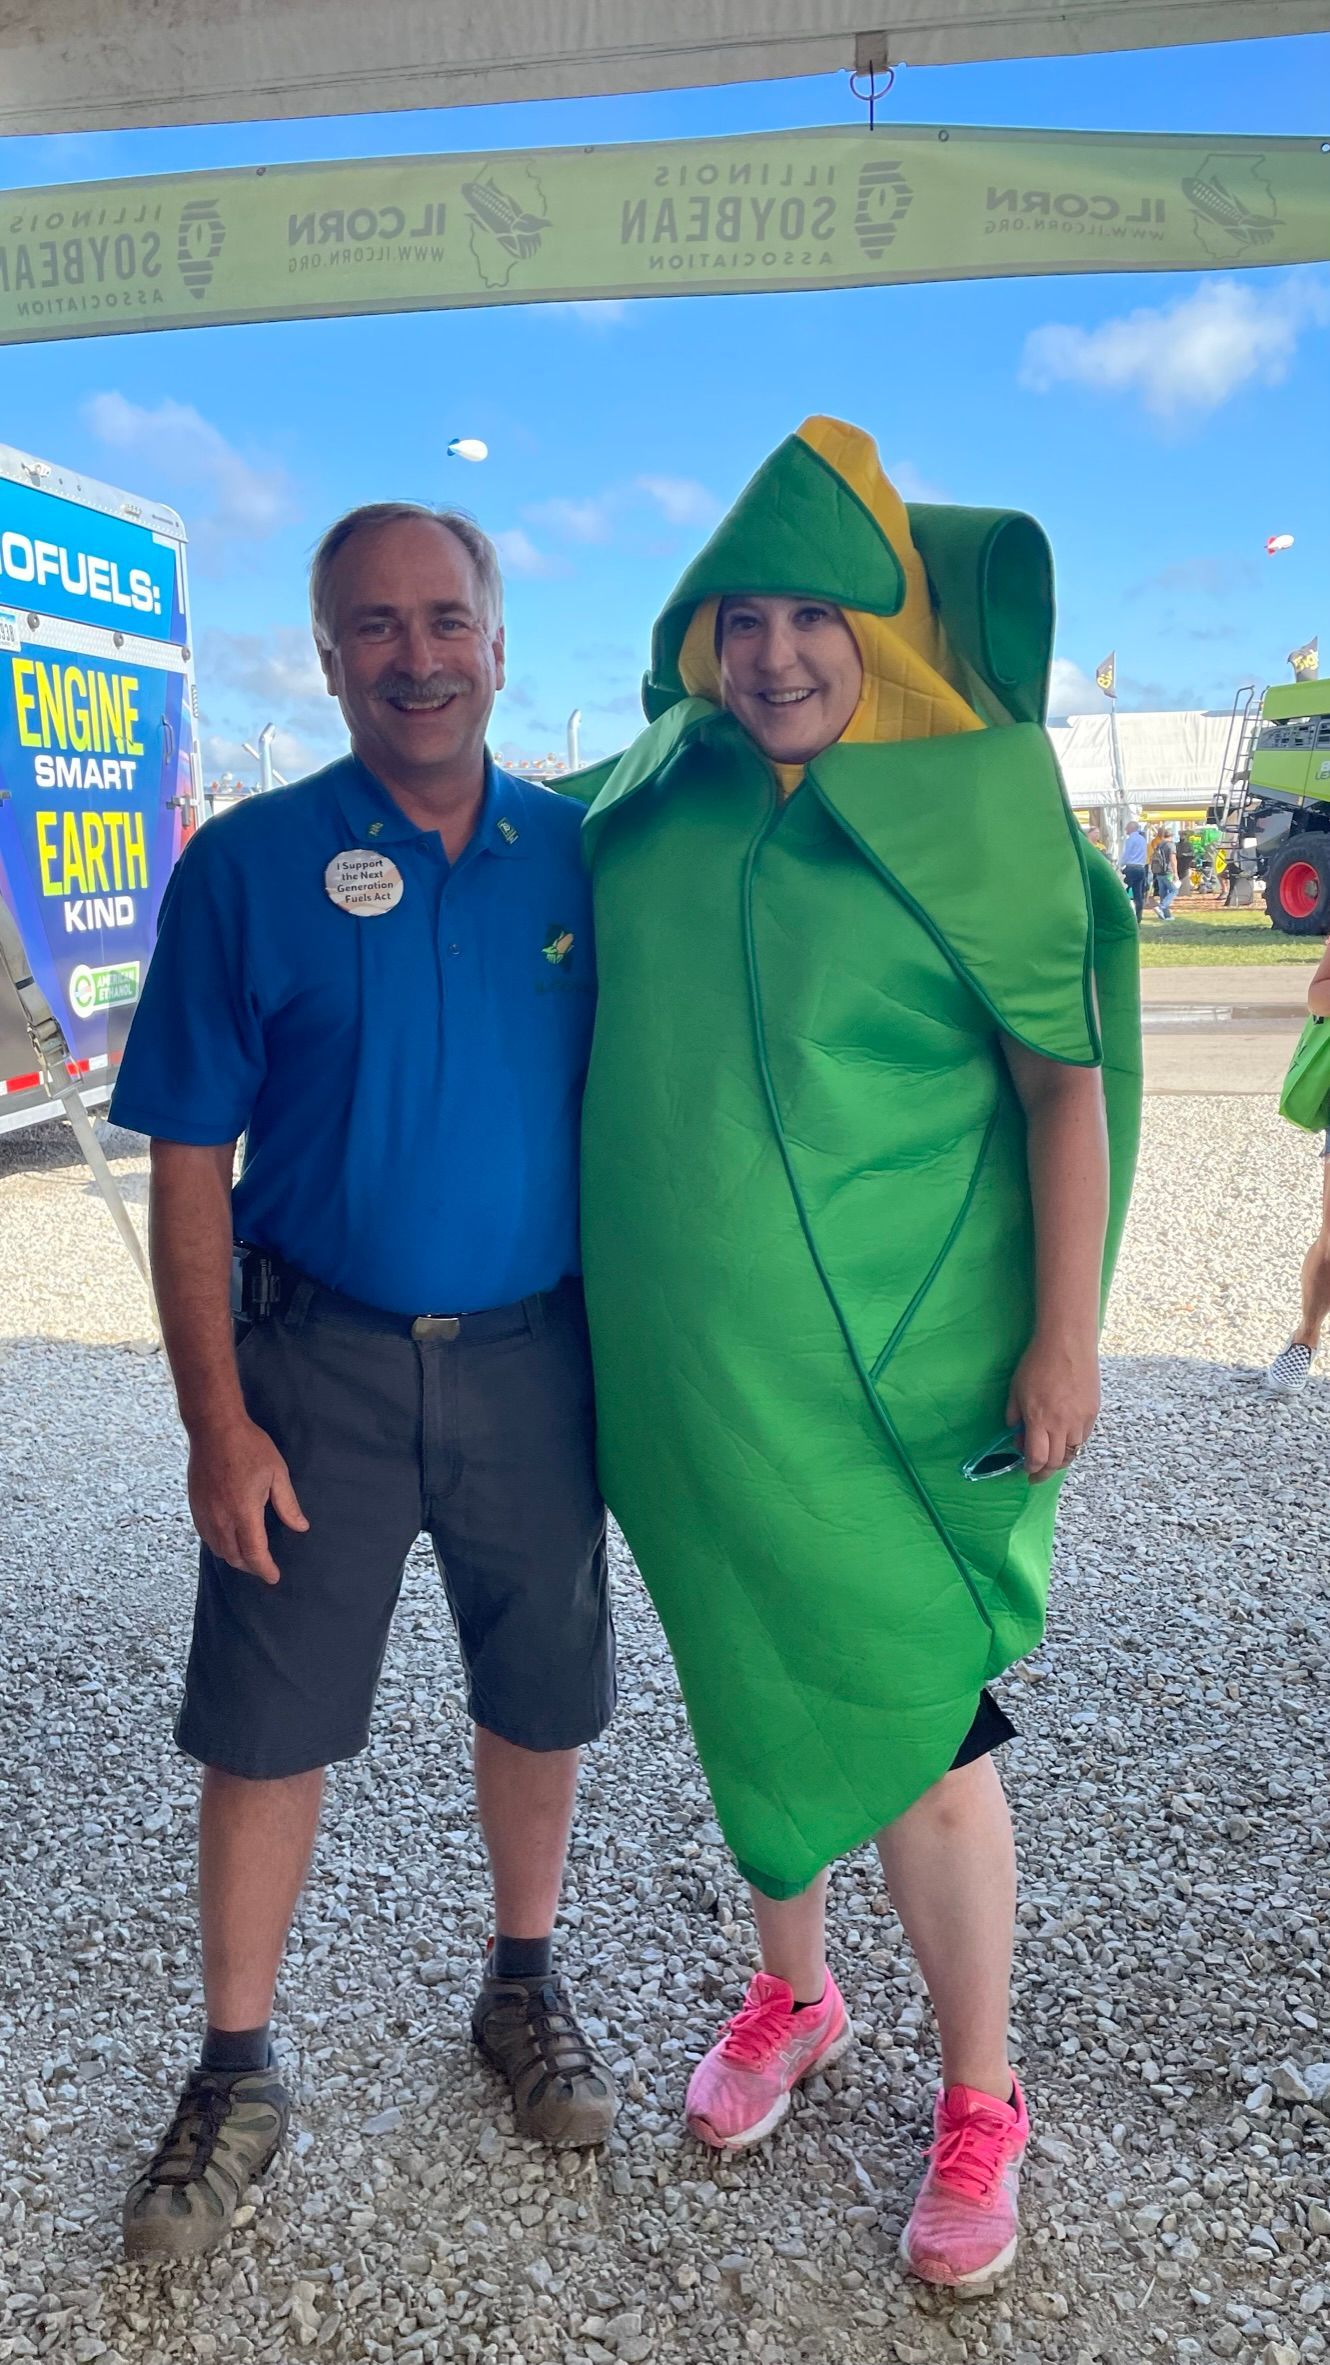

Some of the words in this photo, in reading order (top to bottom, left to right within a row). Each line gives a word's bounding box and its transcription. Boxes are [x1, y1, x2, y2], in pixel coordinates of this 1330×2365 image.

[0, 530, 162, 616] OFUELS:
[12, 657, 145, 756] ENGINE
[34, 754, 137, 790] SMART
[35, 811, 148, 897] EARTH
[342, 860, 383, 870] Support
[337, 881, 394, 893] Generation
[342, 872, 358, 881] the
[361, 871, 383, 880] Next
[345, 893, 372, 903] Fuels
[374, 892, 392, 901] Act
[64, 895, 135, 933] KIND
[98, 984, 132, 1001] ETHANOL
